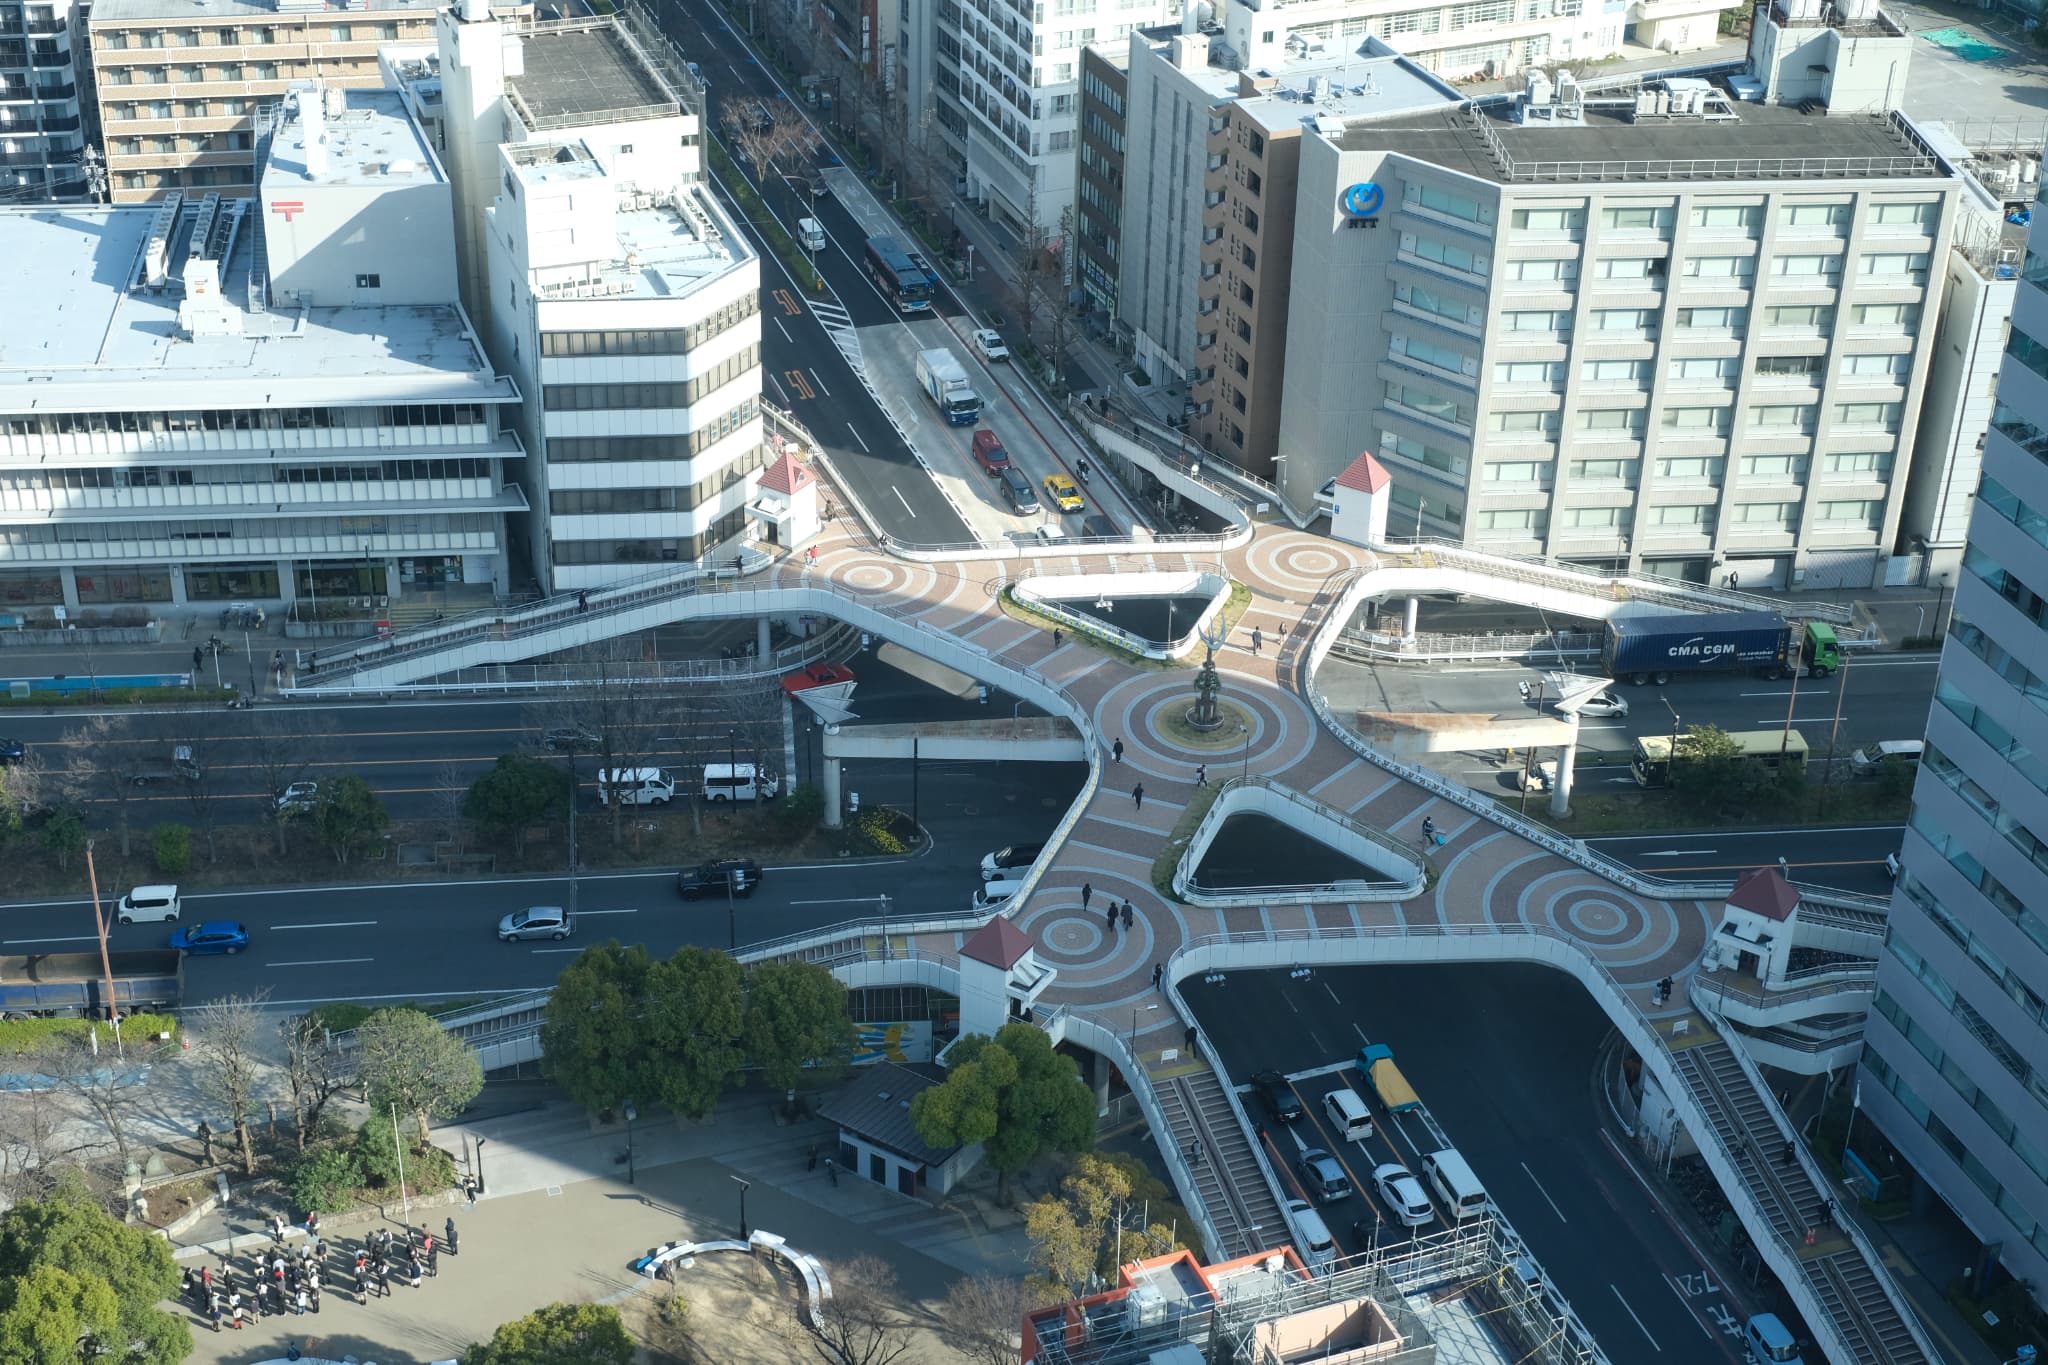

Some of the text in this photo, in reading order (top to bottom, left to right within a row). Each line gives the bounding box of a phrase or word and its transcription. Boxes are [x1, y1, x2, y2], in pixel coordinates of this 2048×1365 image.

[1348, 218, 1379, 229] NTT
[772, 289, 802, 315] 50
[784, 370, 816, 400] 50
[1668, 646, 1700, 656] CMA
[1703, 644, 1735, 655] CGM
